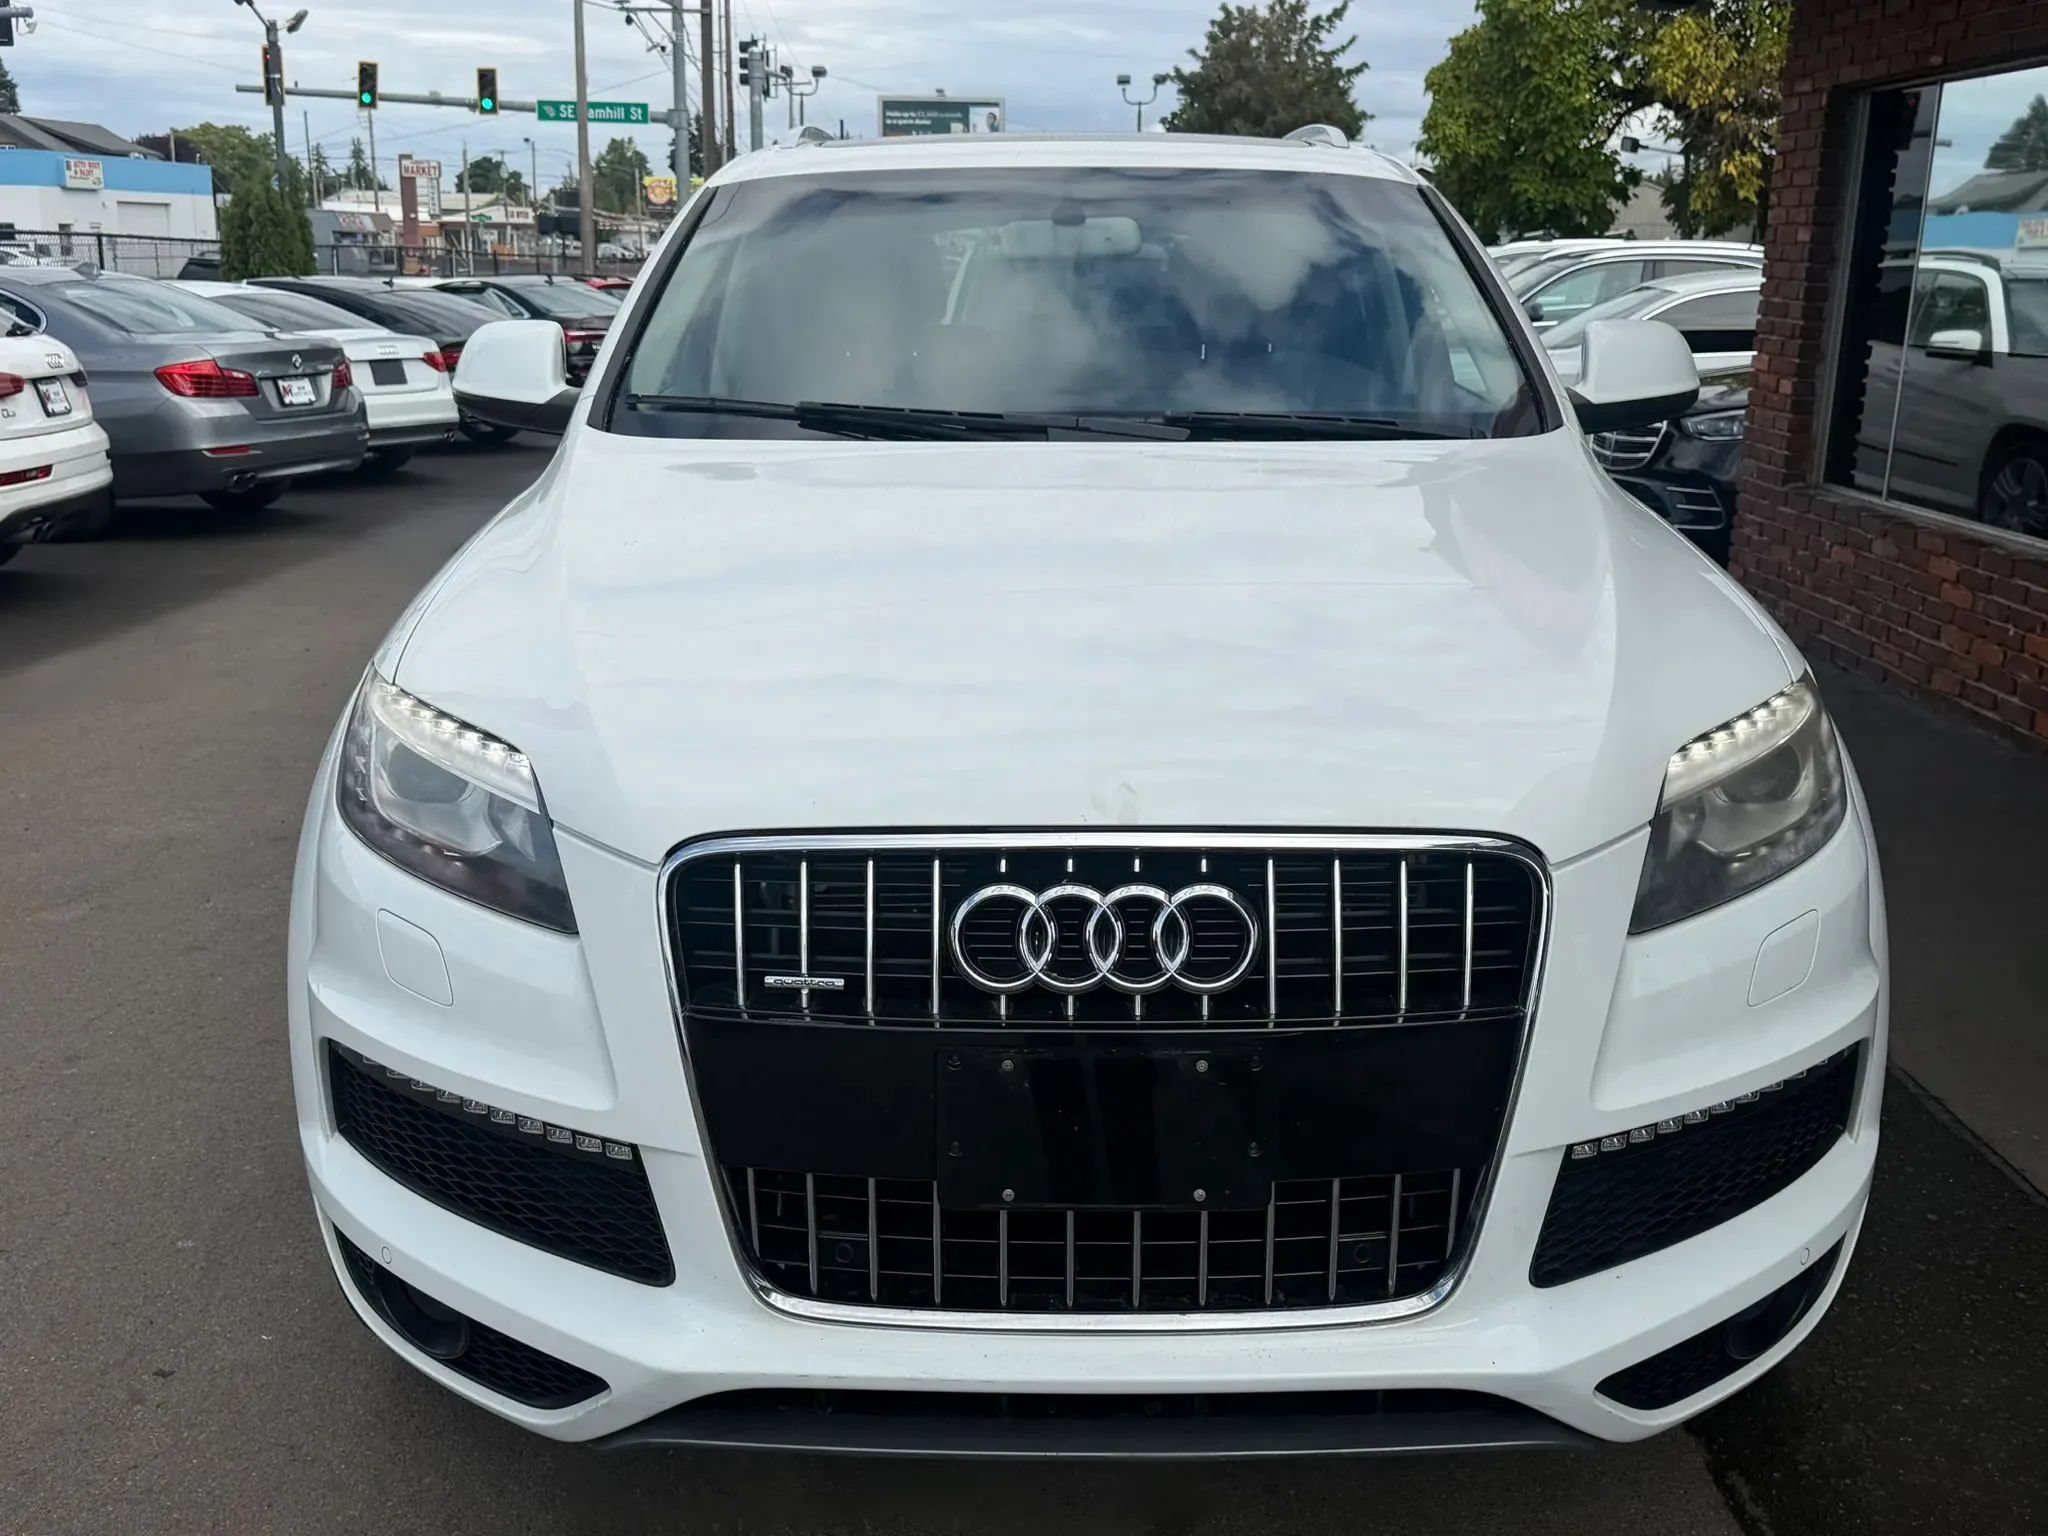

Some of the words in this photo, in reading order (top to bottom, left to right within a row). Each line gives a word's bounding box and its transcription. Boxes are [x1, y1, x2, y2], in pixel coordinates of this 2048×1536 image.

[560, 104, 575, 118] SE
[587, 106, 625, 120] amhill
[630, 106, 643, 120] St
[403, 164, 438, 176] MARKET
